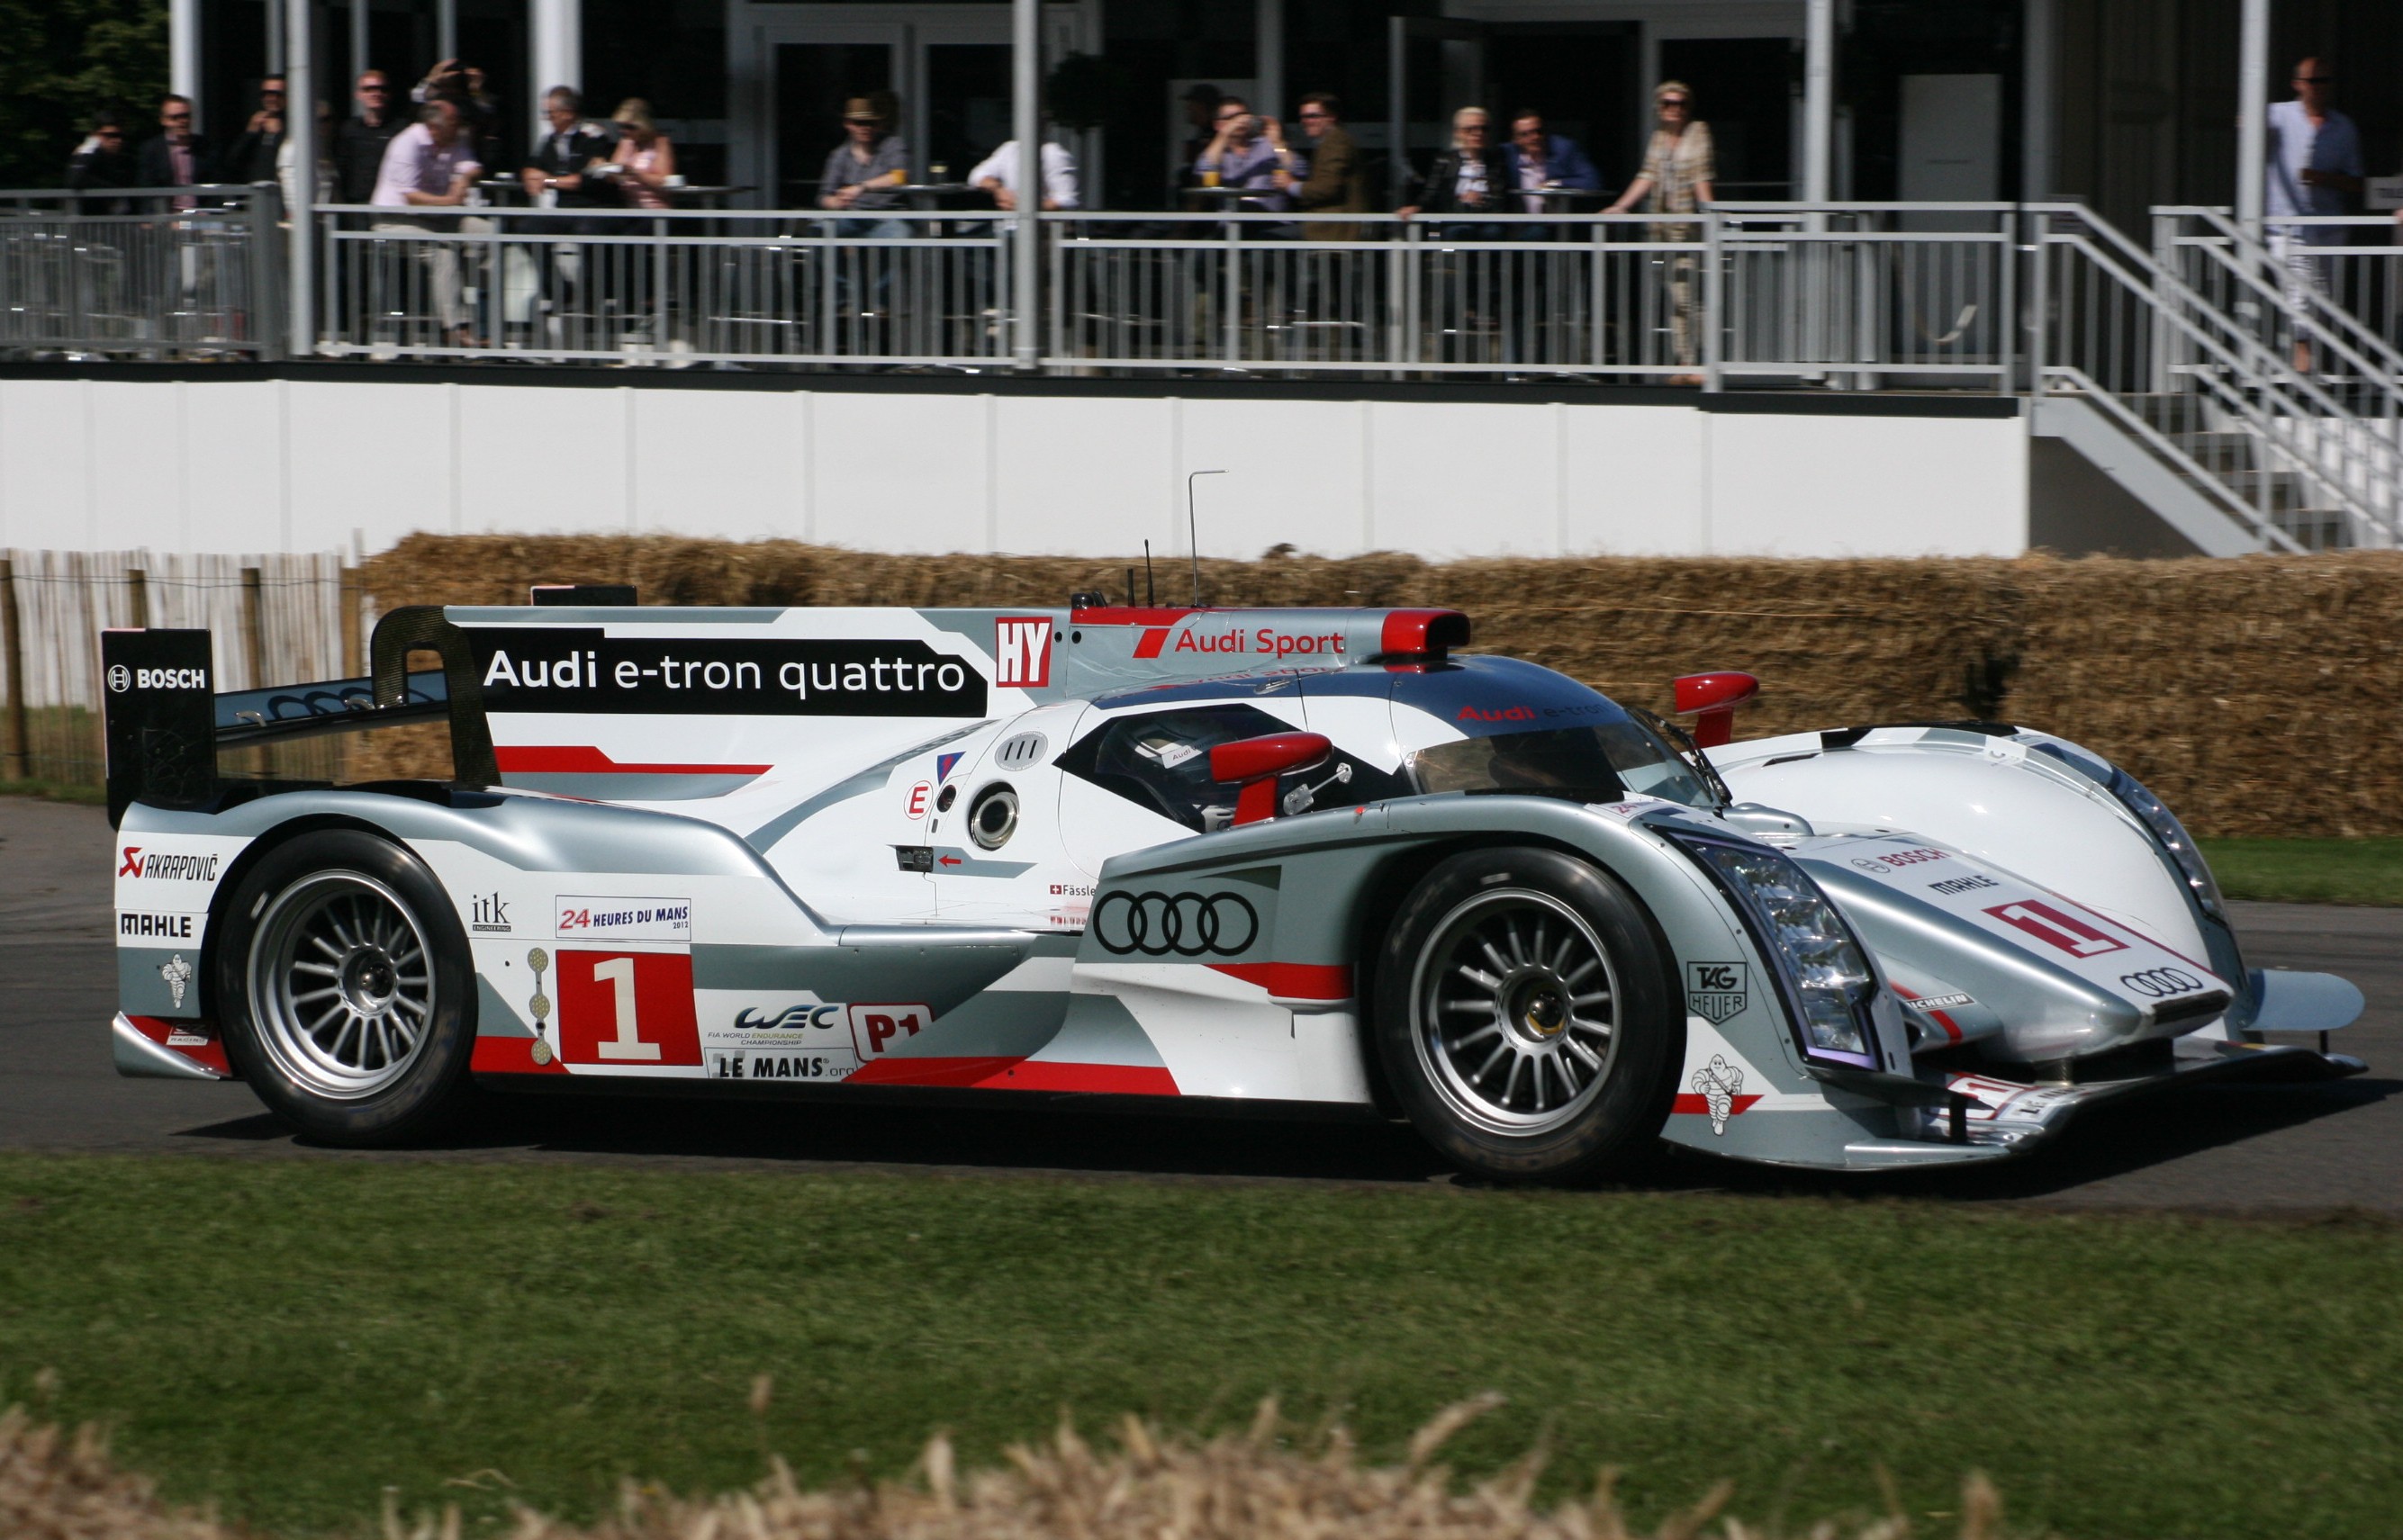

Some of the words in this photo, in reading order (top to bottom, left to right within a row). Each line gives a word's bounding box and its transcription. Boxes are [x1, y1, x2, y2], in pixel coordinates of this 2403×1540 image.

[997, 622, 1051, 682] HY
[1174, 628, 1245, 653] Audi
[1255, 628, 1344, 659] Sport
[136, 668, 206, 689] BOSCH
[483, 650, 597, 689] Audi
[614, 654, 762, 689] e-tron
[779, 657, 965, 700] quattro
[1456, 705, 1537, 721] Audi
[1172, 747, 1191, 761] Audi
[908, 786, 929, 815] E
[1876, 847, 1951, 868] BOSCH
[1927, 875, 2001, 896] MAHLE
[471, 890, 511, 924] itk
[557, 908, 592, 931] 24
[592, 911, 634, 928] HEURES
[637, 909, 653, 924] DU
[655, 905, 689, 923] MANS
[121, 913, 192, 938] MAHLE
[673, 921, 689, 930] 2012
[1696, 965, 1738, 990] TAG
[593, 957, 662, 1061] 1
[733, 1004, 840, 1030] WEC
[1692, 995, 1743, 1021] HEUER
[722, 1031, 751, 1040] WORLD
[719, 1057, 744, 1078] LE
